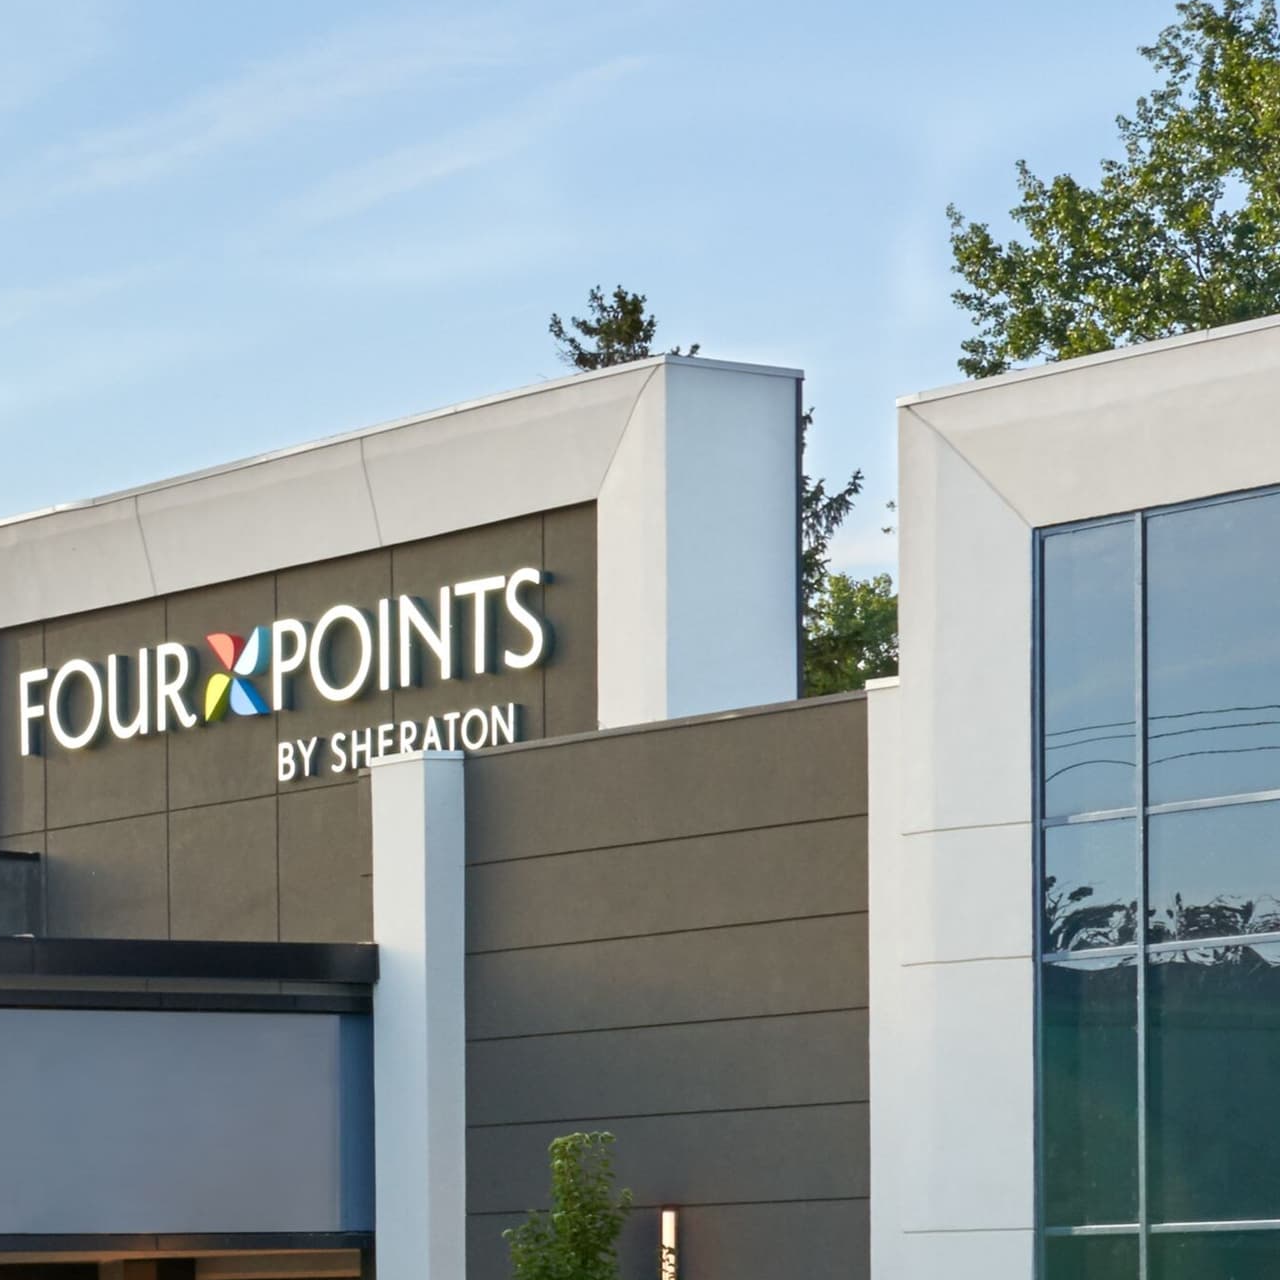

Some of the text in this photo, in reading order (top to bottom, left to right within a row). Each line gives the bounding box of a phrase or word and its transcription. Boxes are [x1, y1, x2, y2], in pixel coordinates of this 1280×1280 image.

[19, 567, 544, 756] FOUR POINTS
[278, 703, 515, 782] BY SHERATON
